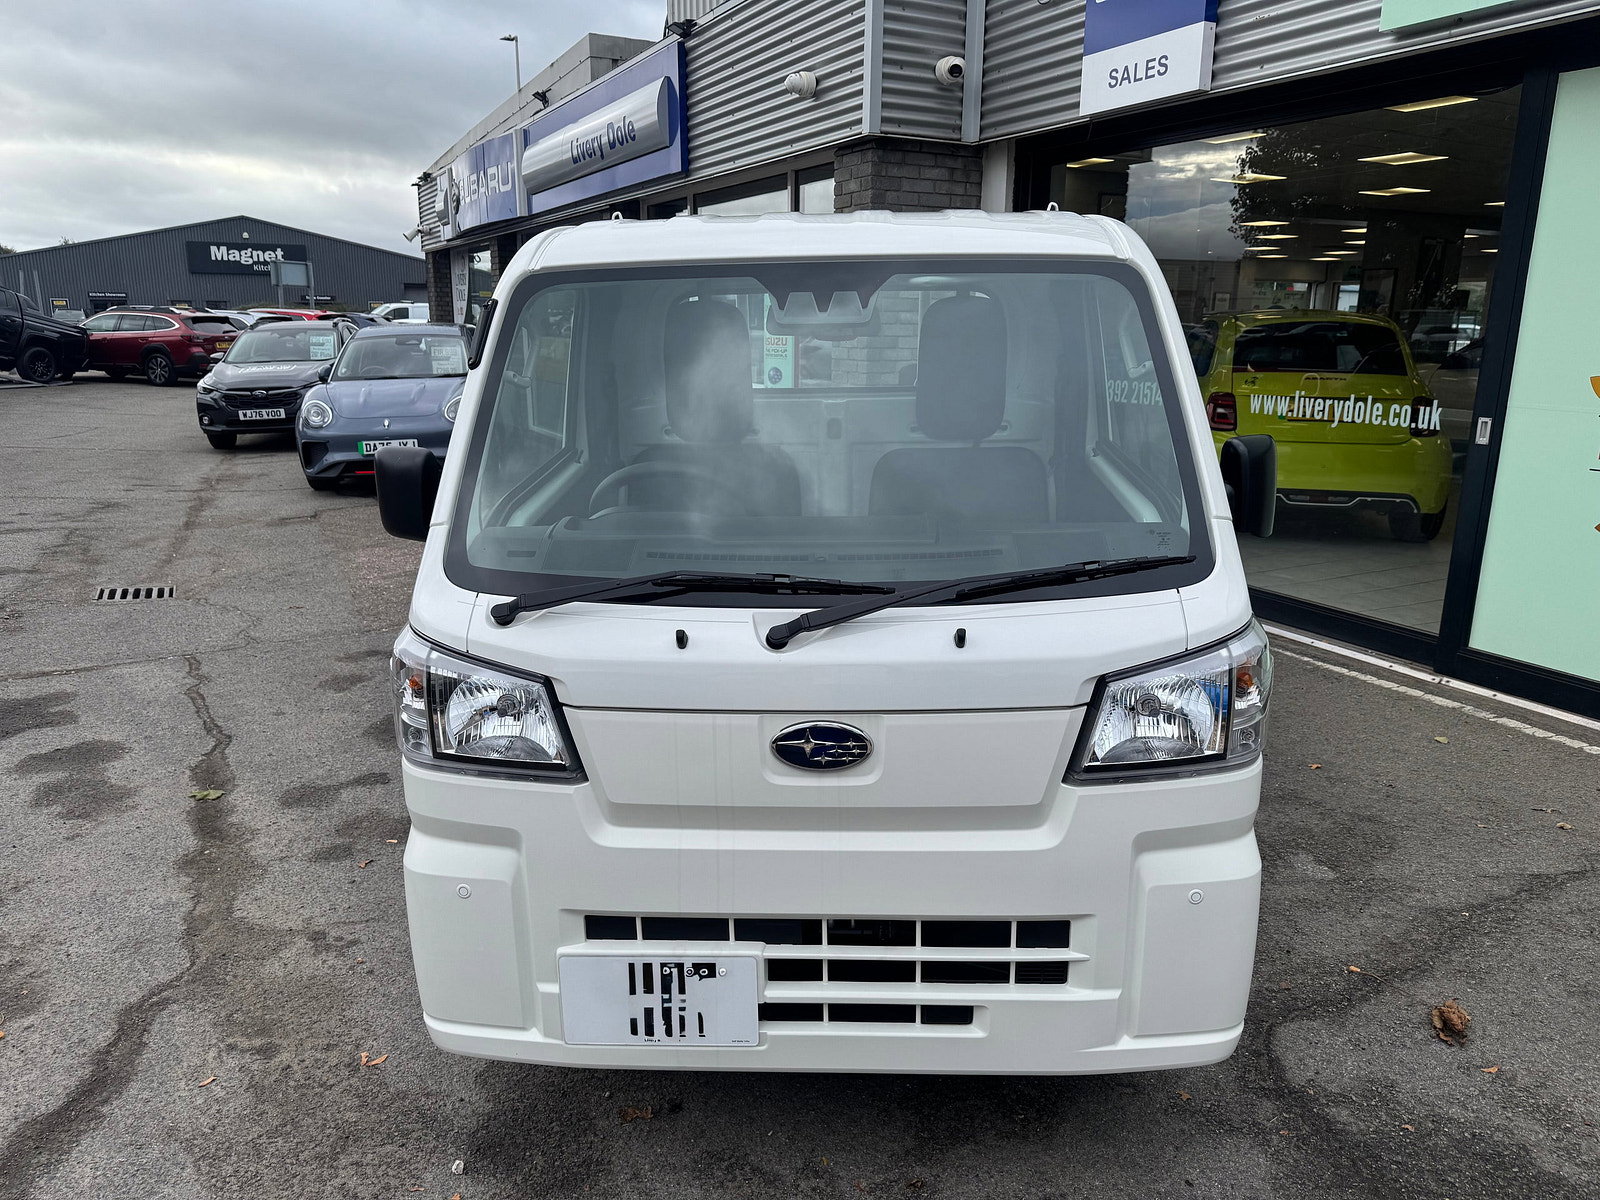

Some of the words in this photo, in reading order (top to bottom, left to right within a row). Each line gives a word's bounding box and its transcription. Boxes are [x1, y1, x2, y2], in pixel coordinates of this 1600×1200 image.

[1108, 54, 1169, 89] SALES
[570, 133, 604, 165] Livery
[606, 115, 636, 150] Dole
[210, 245, 284, 264] Magnet
[765, 337, 788, 346] SUZU
[1250, 390, 1442, 431] www.liverydole.co.uk
